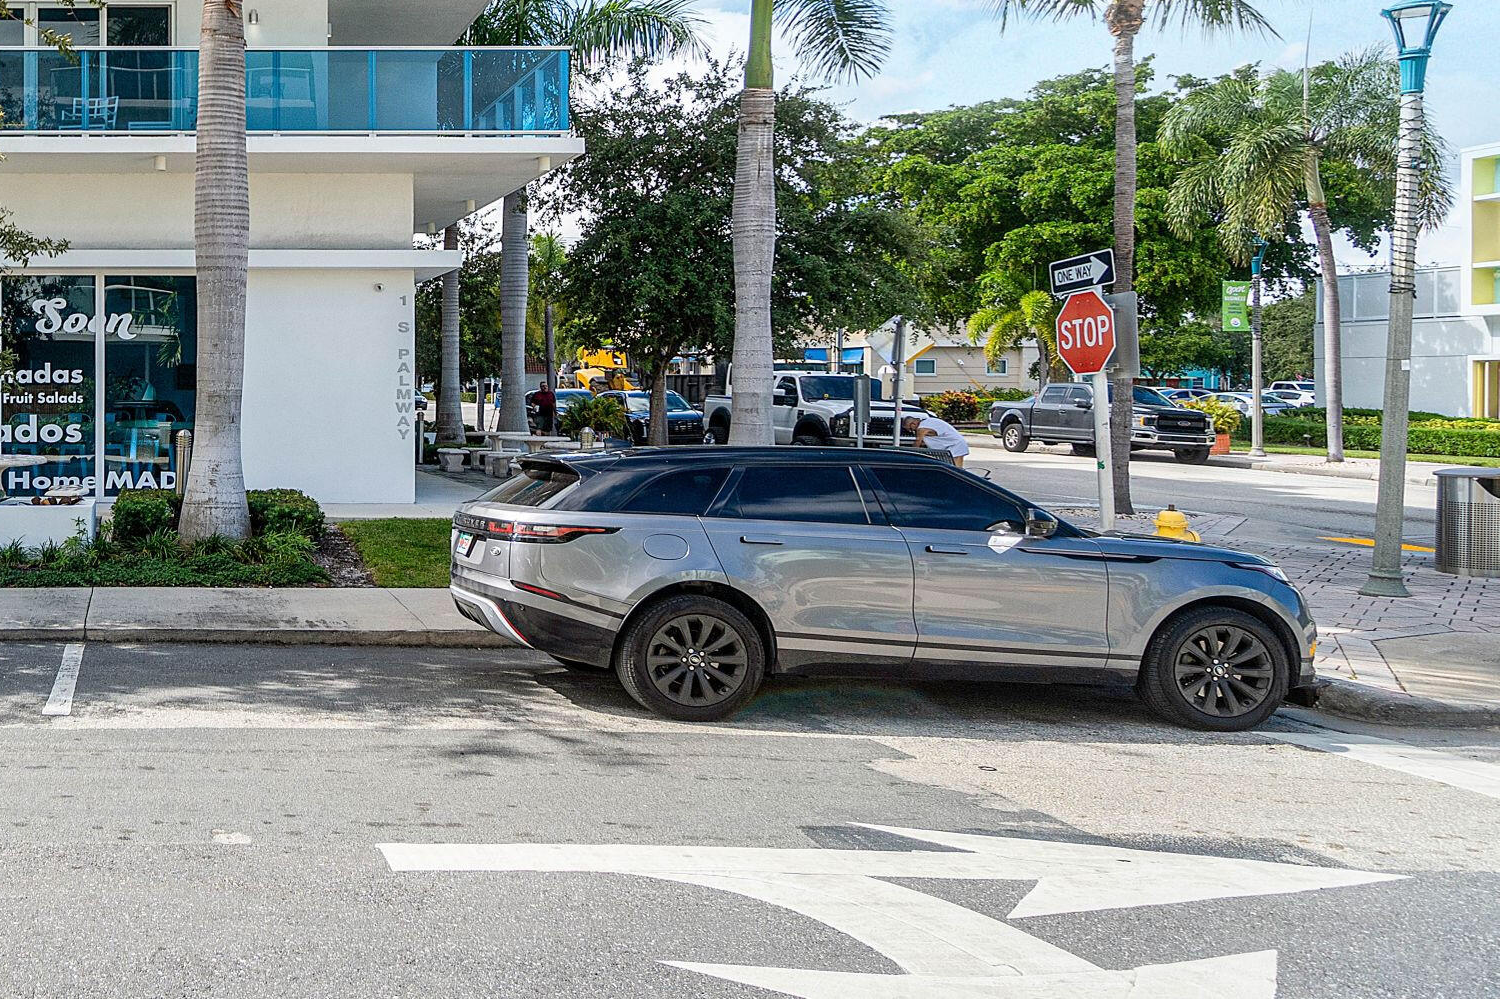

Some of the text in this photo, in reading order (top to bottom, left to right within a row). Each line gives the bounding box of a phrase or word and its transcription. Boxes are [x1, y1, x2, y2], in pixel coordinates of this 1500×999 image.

[1057, 264, 1093, 284] ONE WAY
[399, 295, 407, 306] 1
[32, 298, 137, 340] Soon
[397, 321, 410, 333] S
[1061, 315, 1109, 350] STOP
[2, 391, 34, 404] Fruit
[37, 391, 84, 404] Salads
[8, 471, 96, 490] Home
